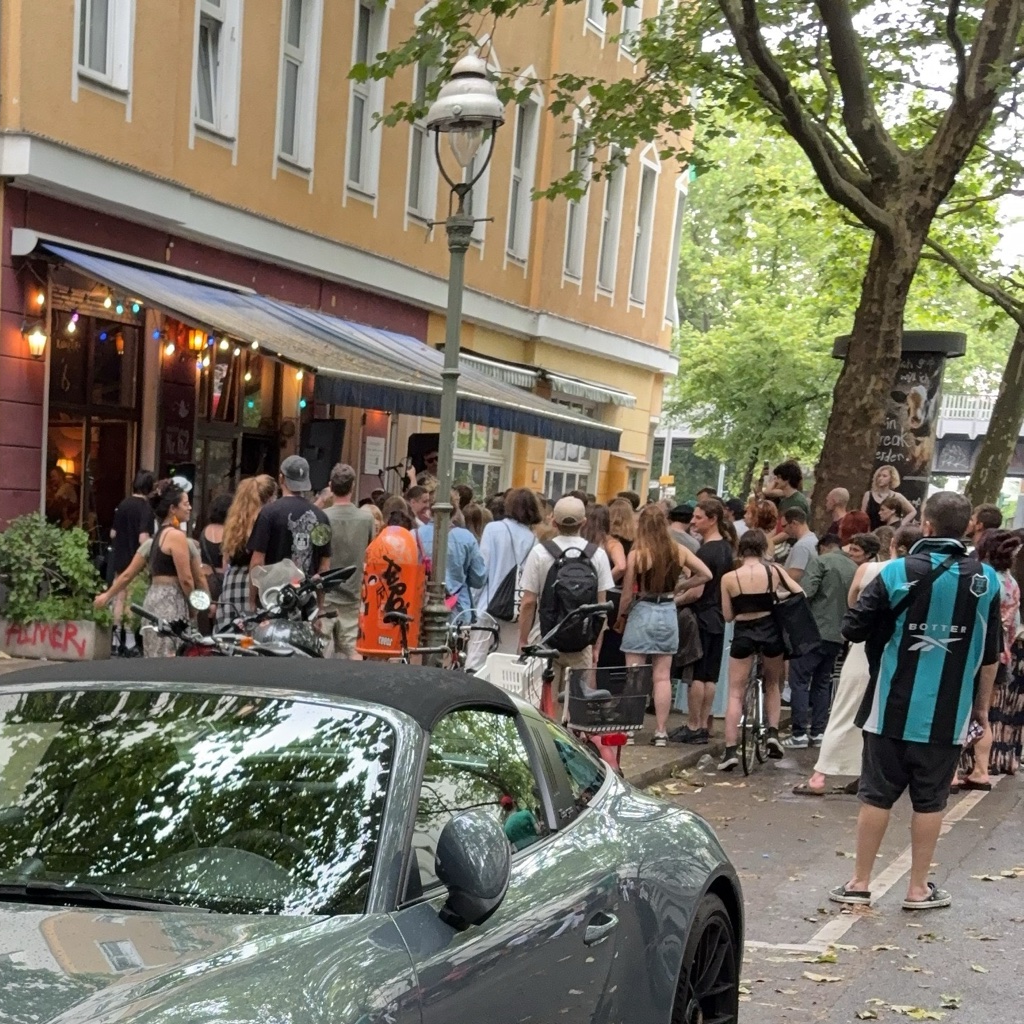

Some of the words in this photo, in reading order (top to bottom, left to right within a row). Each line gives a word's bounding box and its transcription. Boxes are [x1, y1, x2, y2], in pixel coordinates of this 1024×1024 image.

[879, 429, 912, 448] reak
[875, 450, 910, 463] erden.
[909, 623, 967, 633] BOTTER
